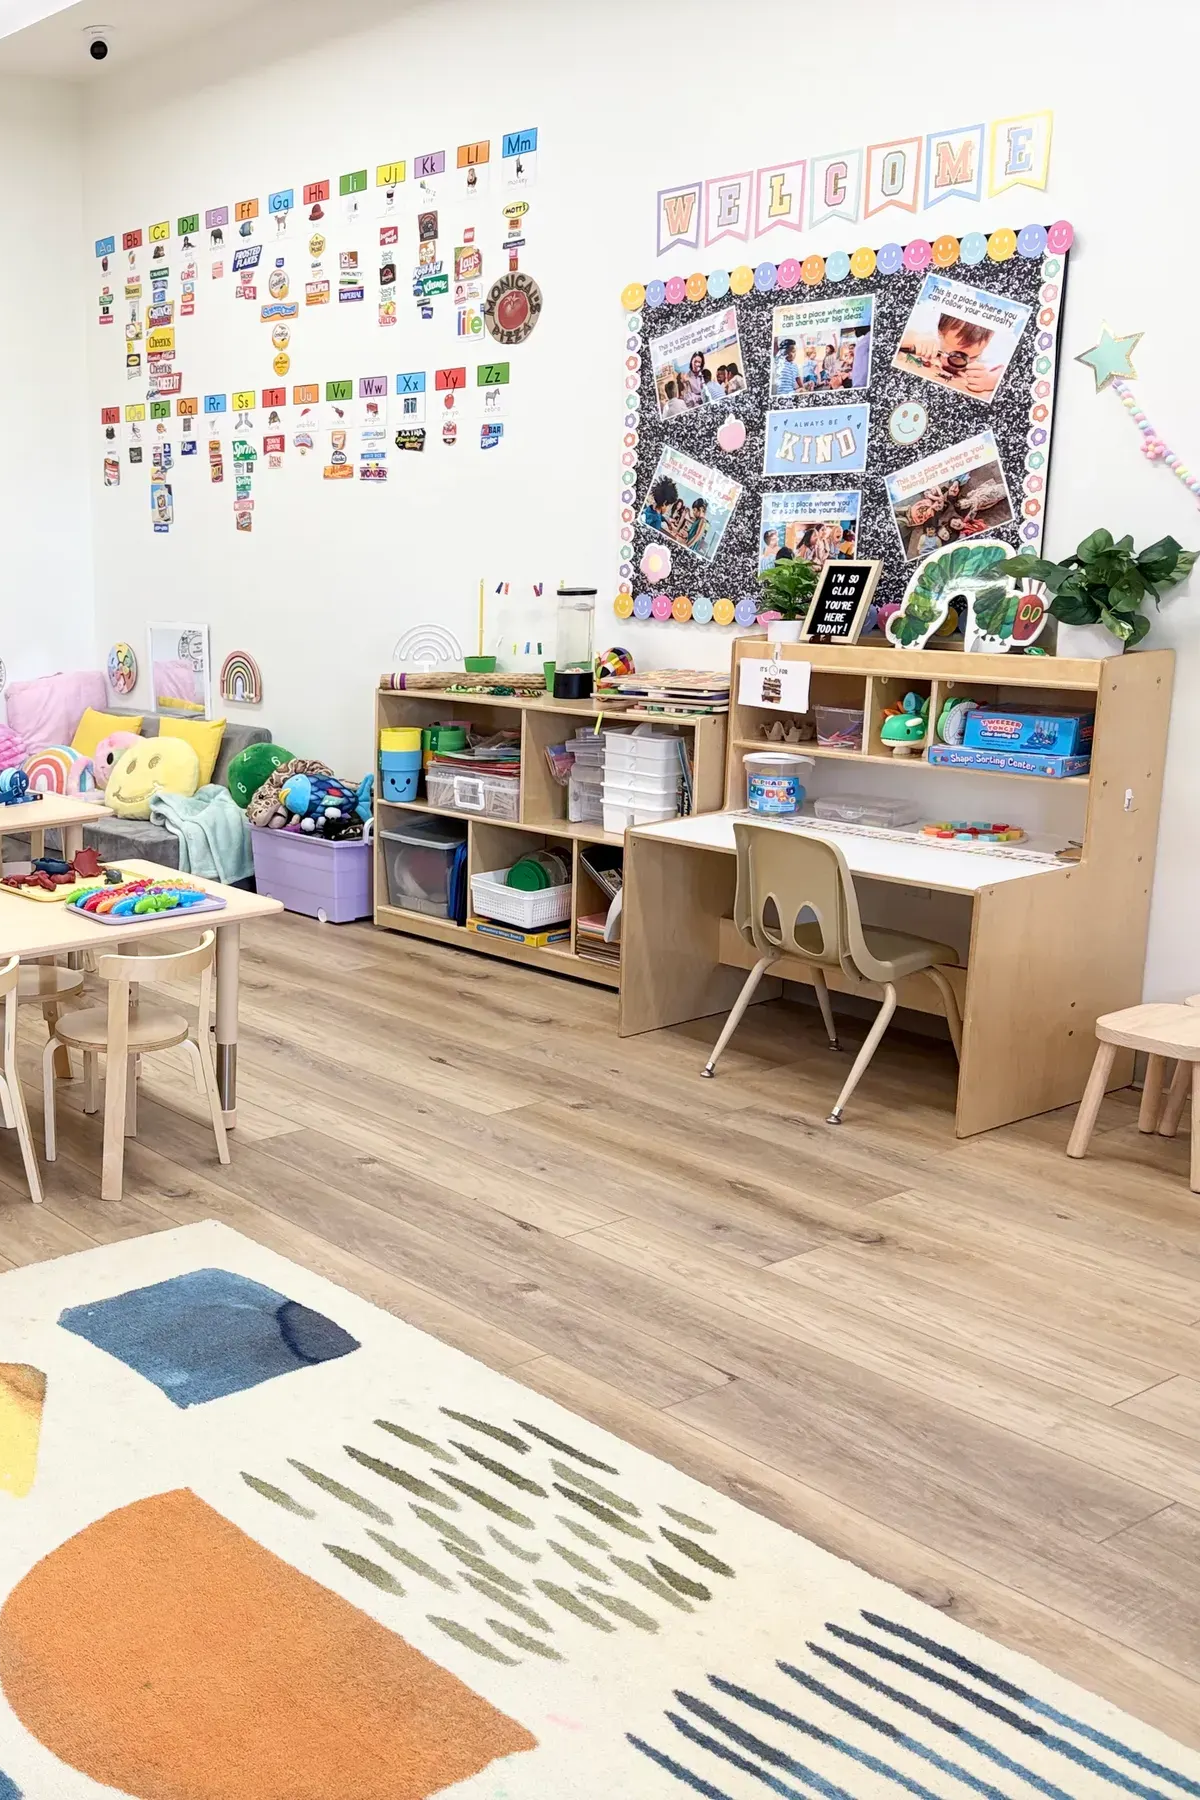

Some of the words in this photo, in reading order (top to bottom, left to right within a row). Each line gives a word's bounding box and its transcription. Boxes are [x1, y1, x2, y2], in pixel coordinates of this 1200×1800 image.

[508, 136, 531, 154] Mm
[467, 146, 478, 164] Ll
[422, 157, 436, 173] Kk
[349, 175, 357, 191] Ii
[384, 167, 398, 188] Jj
[664, 127, 1033, 236] WELCOME
[309, 184, 323, 201] Hh
[241, 203, 252, 218] Ff
[182, 217, 194, 233] Dd
[211, 211, 222, 225] Ee
[153, 226, 165, 240] Cc
[100, 242, 112, 254] Aa
[127, 234, 138, 248] Bb
[235, 247, 260, 260] FROSTED
[237, 255, 258, 268] FLAKES
[460, 254, 479, 272] Lay's
[928, 293, 940, 301] can
[941, 297, 962, 309] follow
[965, 306, 980, 315] your
[933, 285, 944, 296] This
[959, 295, 977, 306] place
[980, 301, 1002, 314] where
[1004, 311, 1018, 320] you
[808, 311, 825, 319] place
[852, 305, 864, 313] you
[458, 308, 482, 336] life
[816, 317, 829, 325] your
[493, 323, 531, 344] PIZZA
[485, 367, 500, 382] Zz
[364, 380, 382, 394] Ww
[403, 377, 418, 391] Xx
[443, 372, 457, 392] Yy
[269, 391, 278, 405] Tt
[301, 389, 312, 401] Uu
[333, 384, 346, 398] Vv
[209, 397, 220, 410] Rr
[238, 395, 248, 408] Ss
[106, 411, 114, 422] Nn
[777, 427, 857, 464] KIND
[924, 462, 942, 475] place
[945, 451, 968, 465] where
[971, 445, 984, 454] you
[360, 470, 387, 478] WONDER
[902, 478, 924, 491] belong
[925, 471, 938, 483] just
[951, 461, 964, 471] you
[832, 574, 845, 583] I'M
[849, 575, 859, 583] SO
[832, 587, 855, 595] GLAD
[825, 600, 853, 610] YOU'RE
[824, 613, 846, 622] HERE
[816, 623, 848, 634] TODAY!
[981, 719, 1023, 729] TWEEZER
[988, 725, 1014, 733] TONGS
[951, 754, 974, 764] Shape
[976, 755, 1005, 767] Sorting
[1008, 758, 1036, 771] Center
